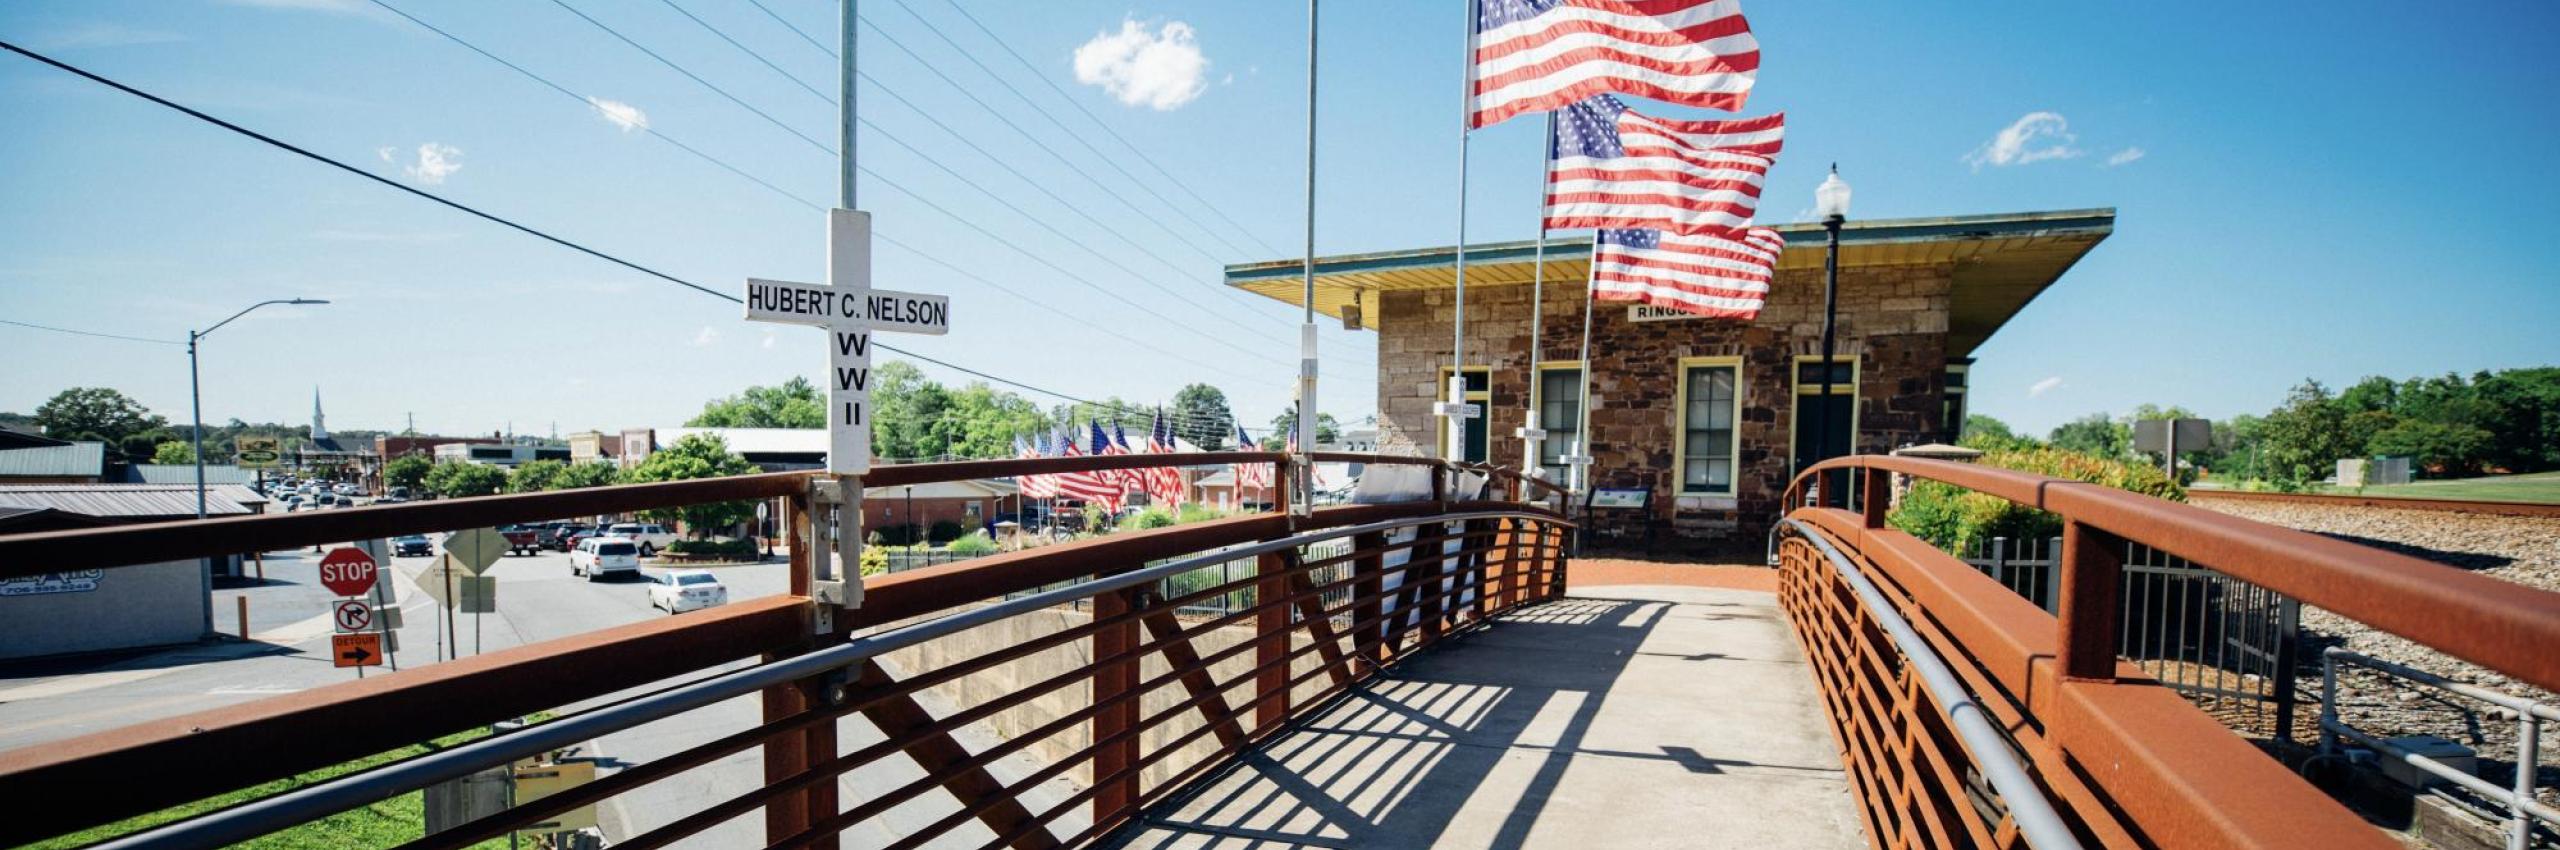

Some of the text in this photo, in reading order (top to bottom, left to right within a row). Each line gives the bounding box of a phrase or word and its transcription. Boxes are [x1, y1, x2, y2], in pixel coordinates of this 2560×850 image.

[748, 284, 947, 327] HUBERT C. NELSON
[323, 562, 374, 583] STOP
[336, 636, 376, 647] DETOUR
